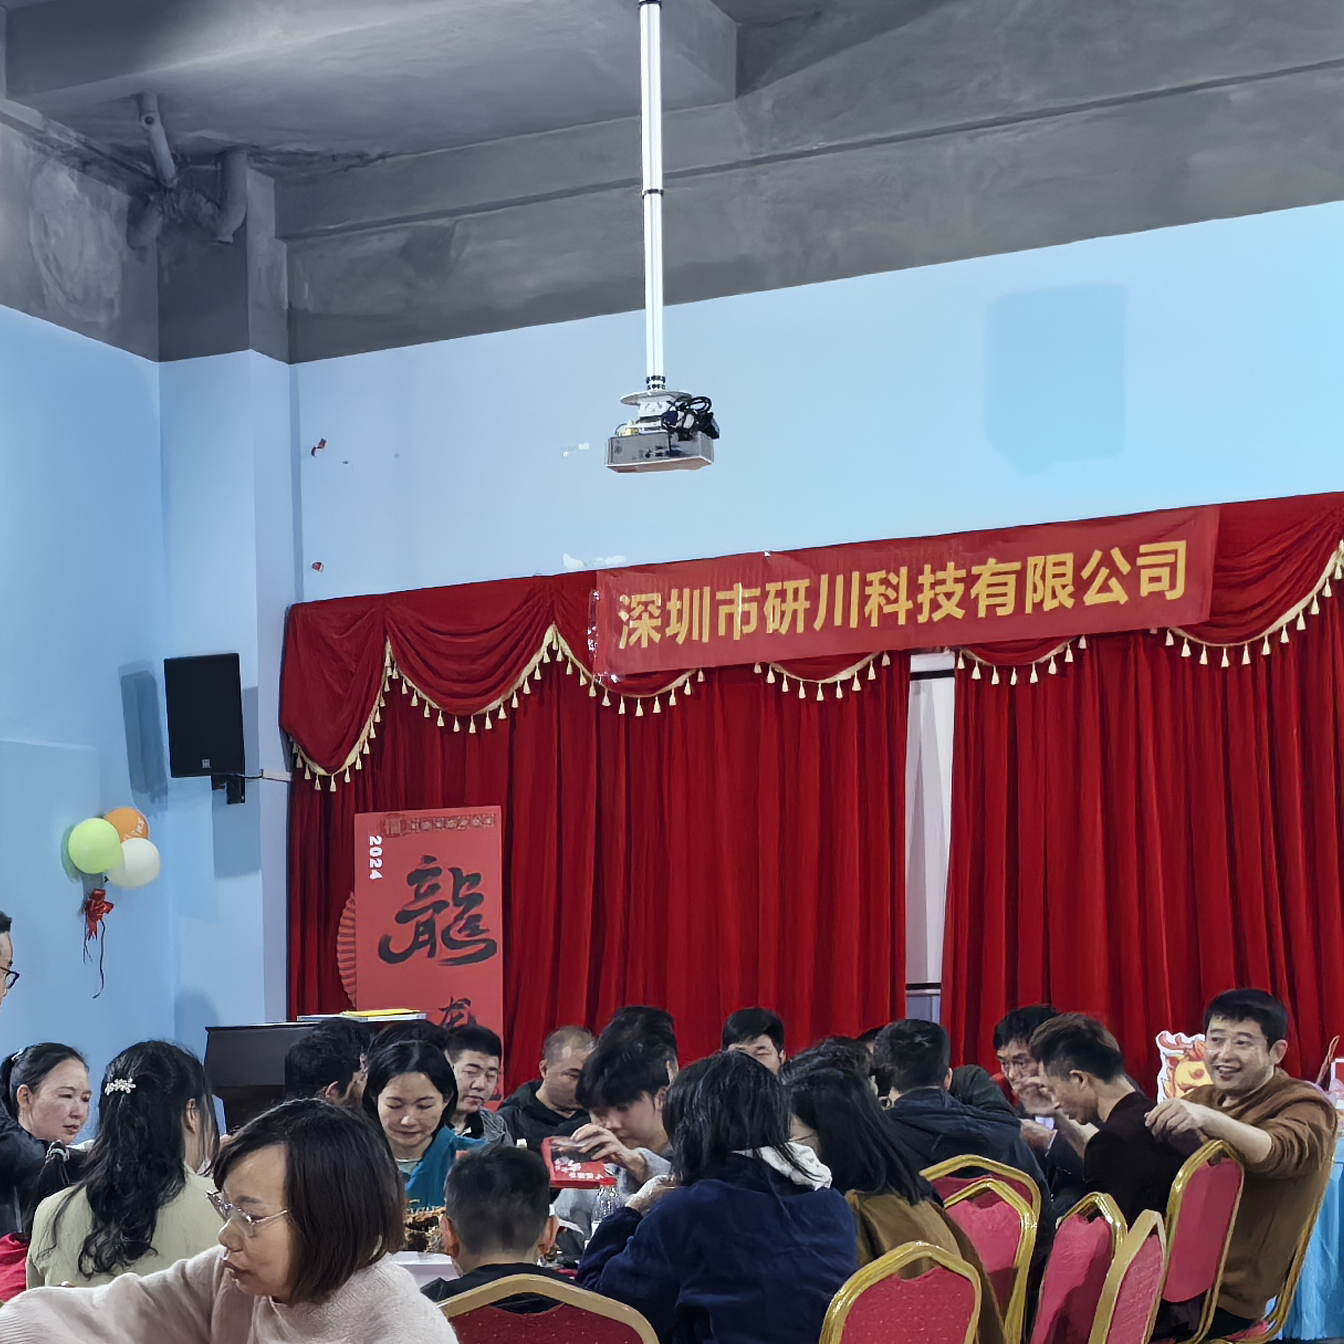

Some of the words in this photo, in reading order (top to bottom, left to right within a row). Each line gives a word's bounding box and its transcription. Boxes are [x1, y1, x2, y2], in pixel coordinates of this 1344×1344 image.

[618, 539, 1188, 649] 深圳市研川科技有限公司
[368, 834, 384, 881] 2024
